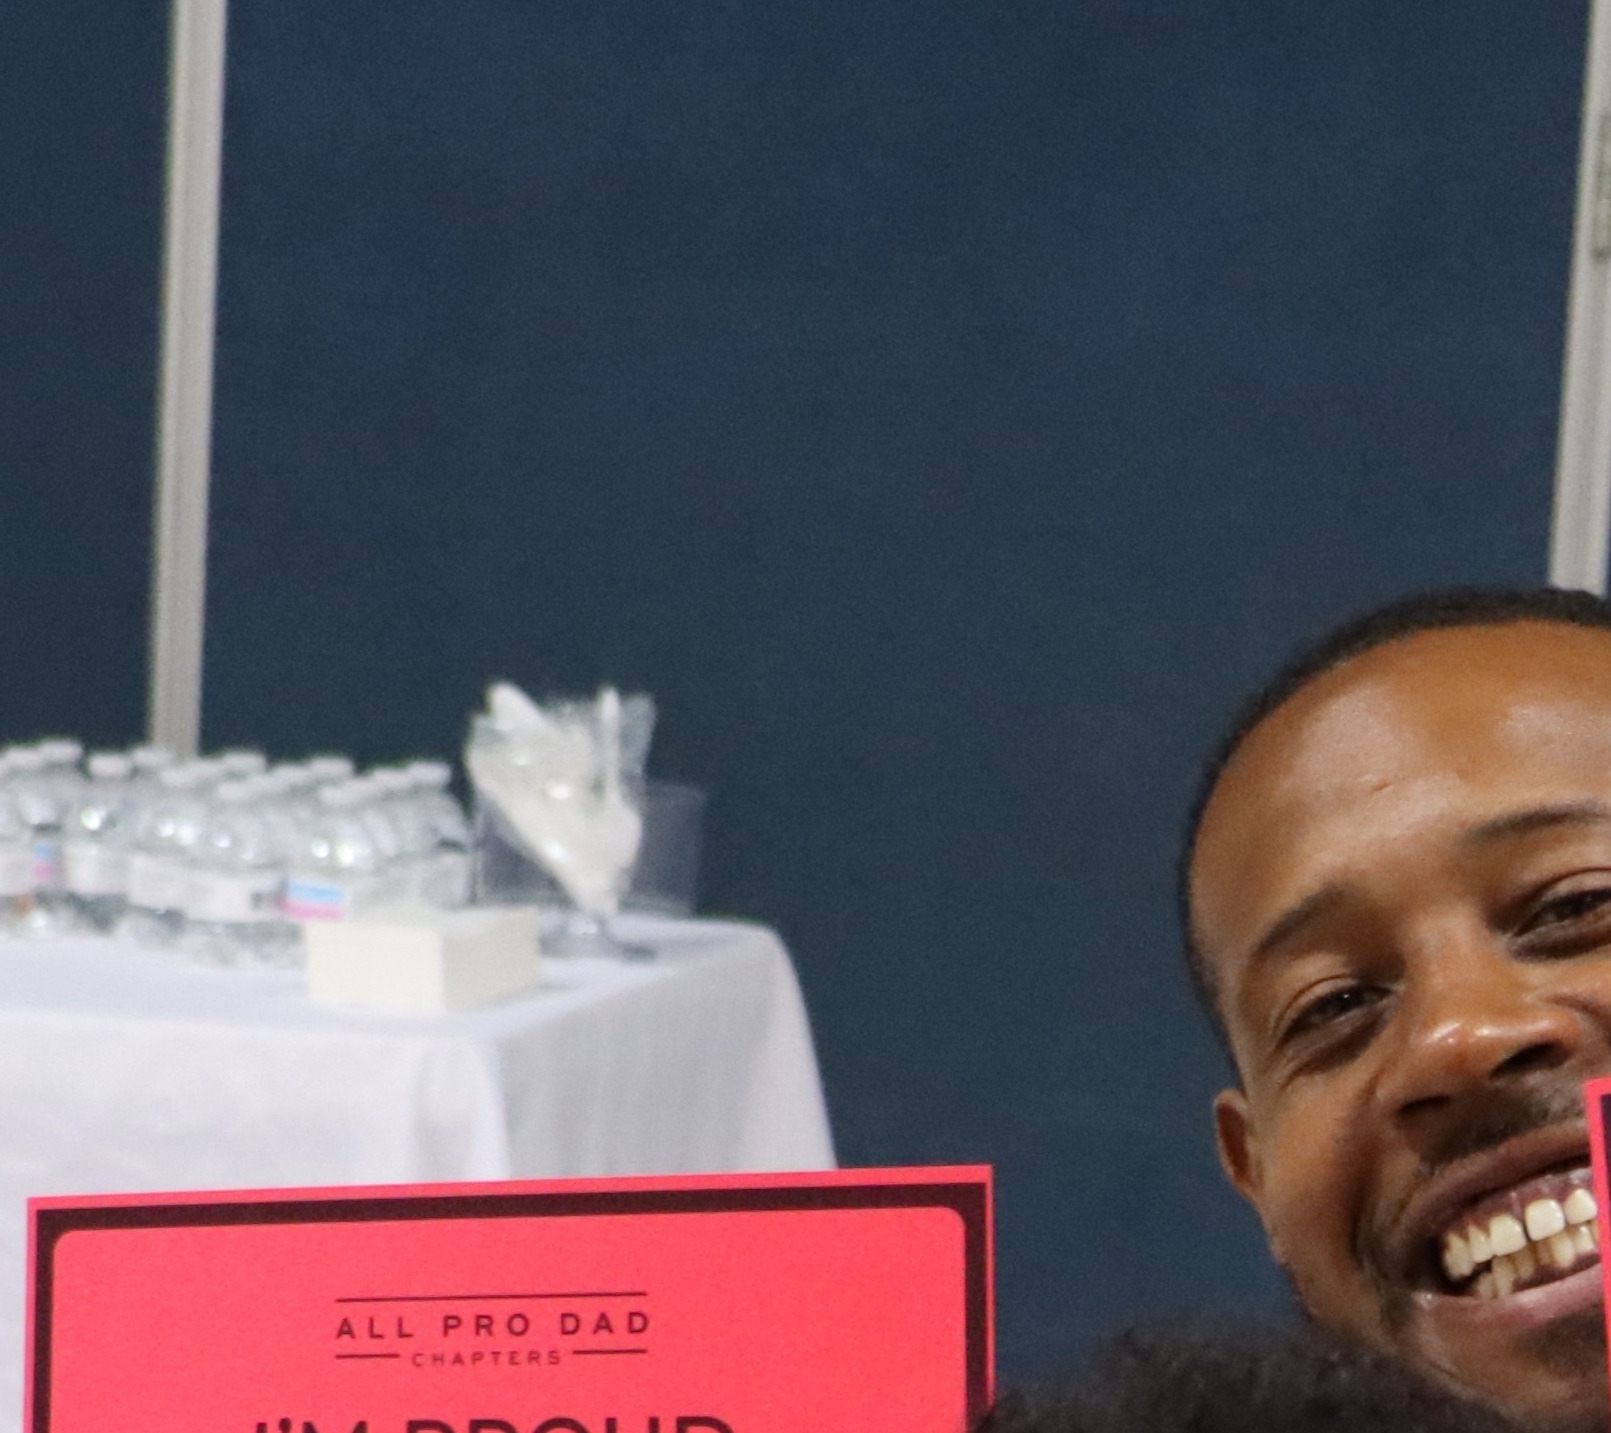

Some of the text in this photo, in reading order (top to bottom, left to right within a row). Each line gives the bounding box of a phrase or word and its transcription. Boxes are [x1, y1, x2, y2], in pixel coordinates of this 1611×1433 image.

[335, 1311, 650, 1340] ALL PRO DAD
[410, 1350, 563, 1368] CHAPTERS
